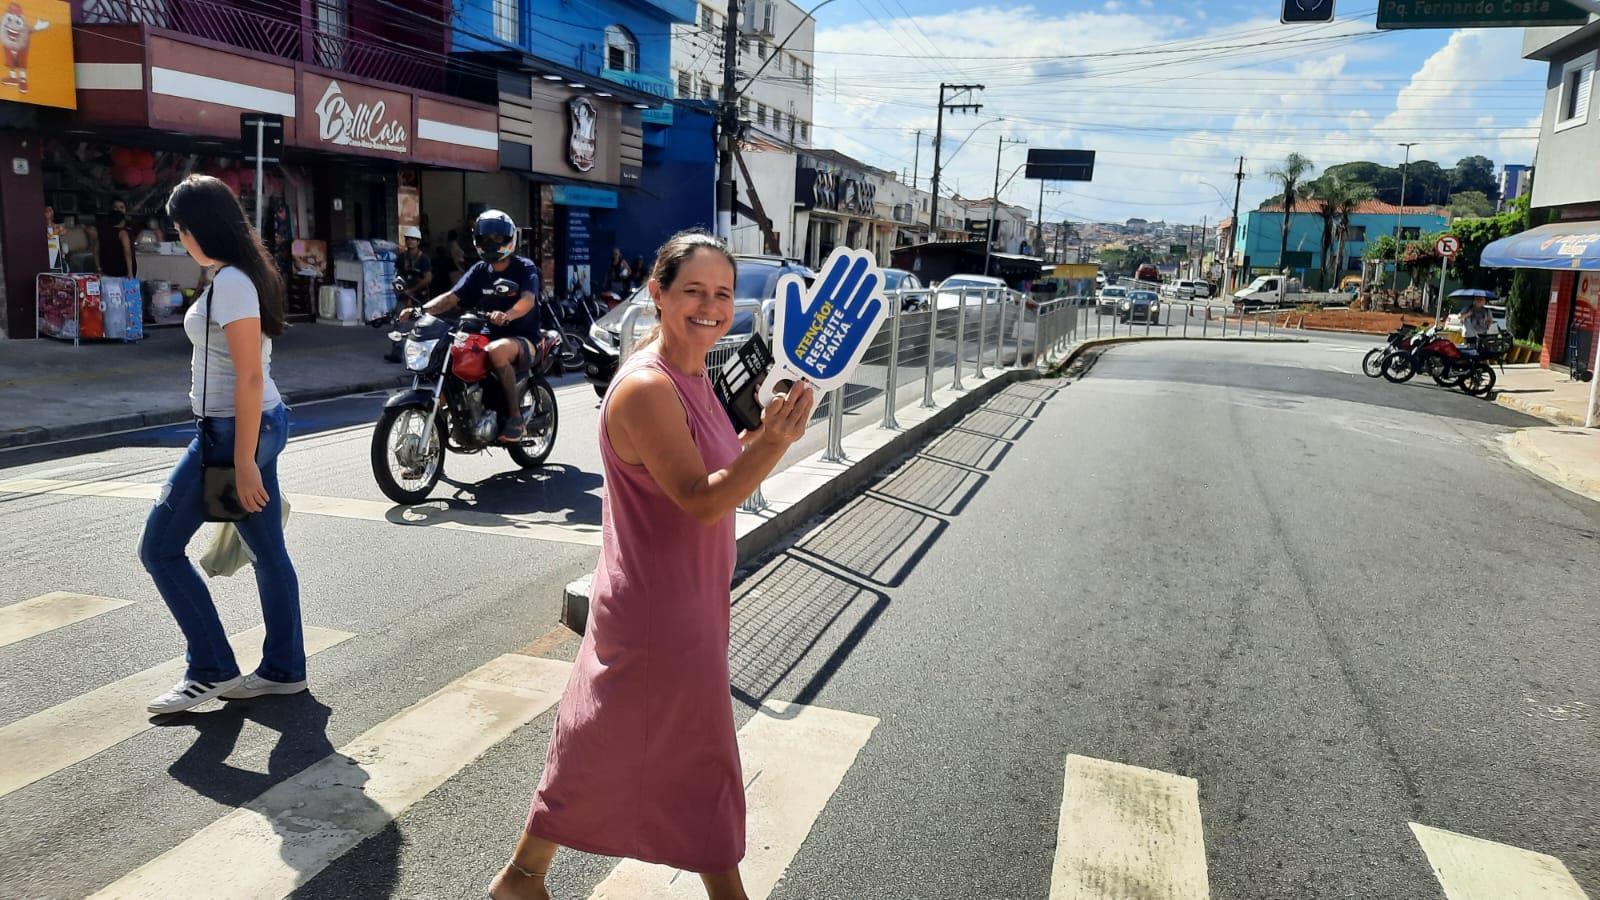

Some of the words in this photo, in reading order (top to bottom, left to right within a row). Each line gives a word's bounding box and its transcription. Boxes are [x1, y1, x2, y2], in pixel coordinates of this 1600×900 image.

[1414, 0, 1495, 15] Fernando
[1502, 0, 1550, 14] Costa
[624, 79, 669, 98] DENTISTA
[794, 300, 834, 360] ATENÇÃO!
[805, 309, 845, 367] RESPEITE
[815, 364, 827, 374] A
